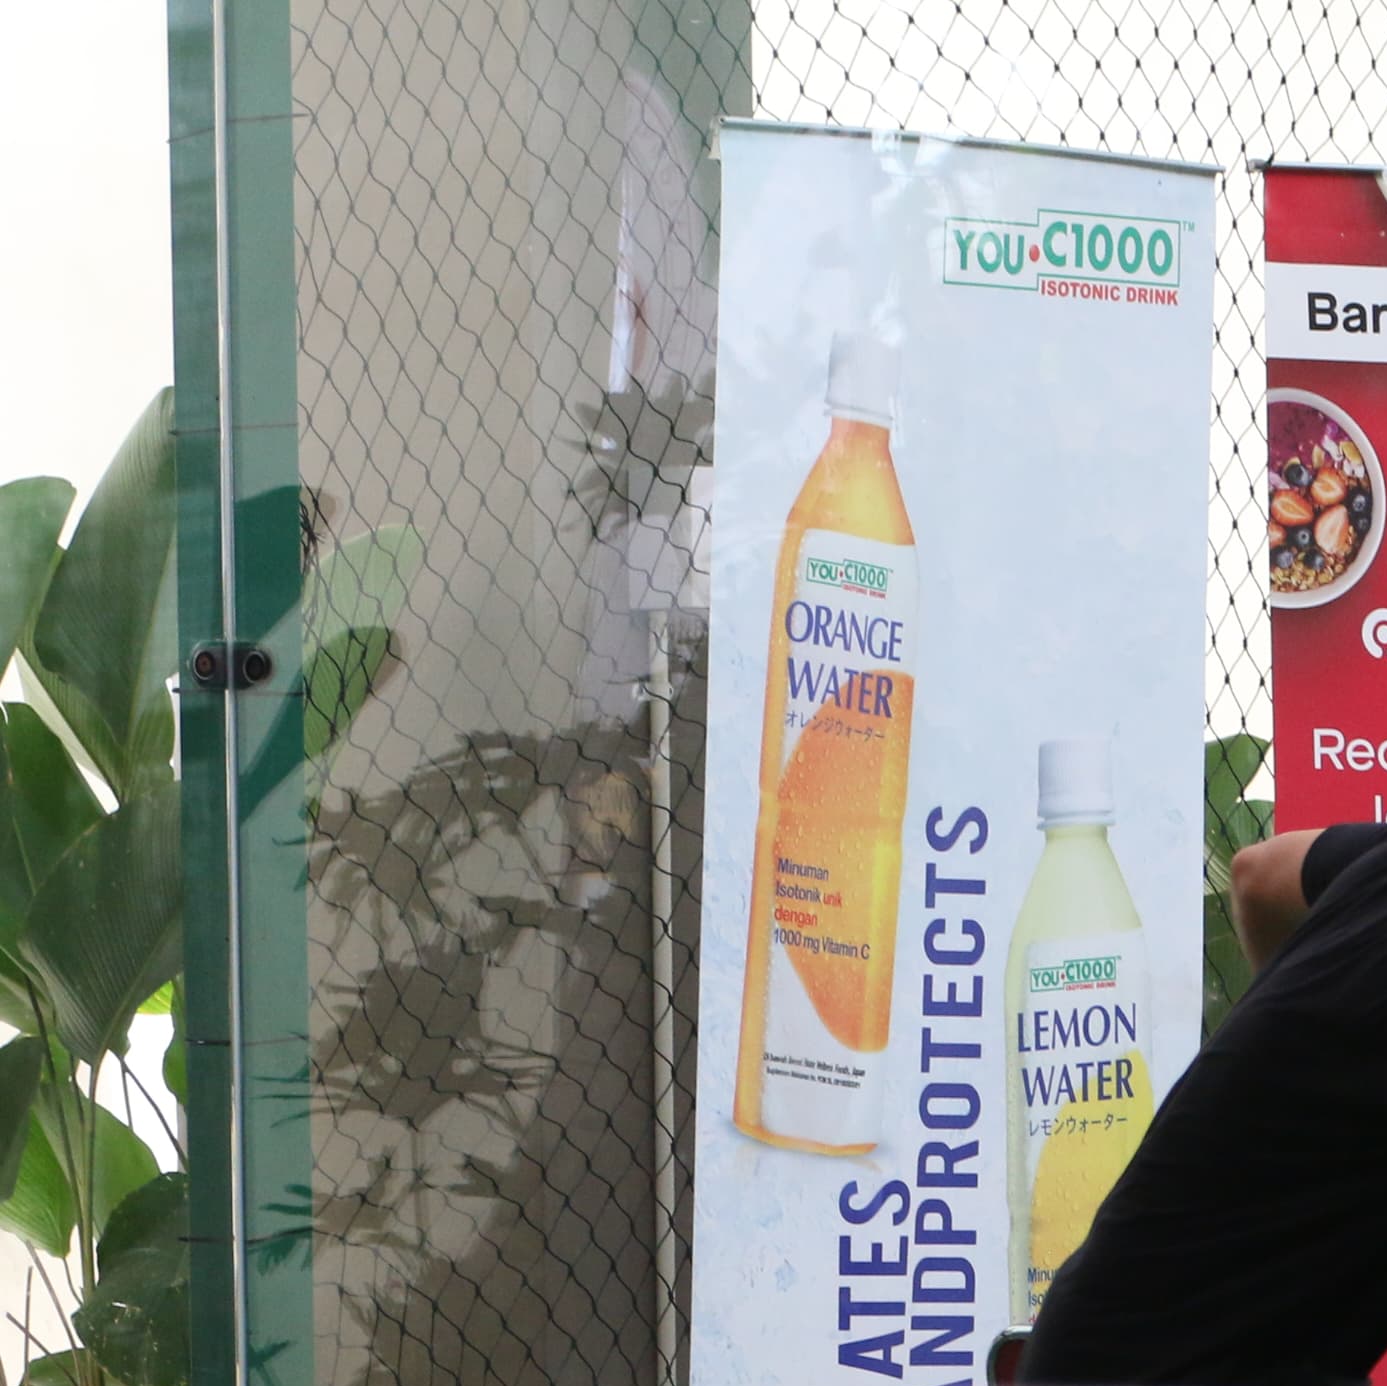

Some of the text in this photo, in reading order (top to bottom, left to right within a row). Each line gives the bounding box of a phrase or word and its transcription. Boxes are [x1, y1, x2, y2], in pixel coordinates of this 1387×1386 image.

[1041, 279, 1178, 306] ISOTONIC DRINK
[785, 601, 903, 662] ORANGE
[787, 657, 893, 719] WATER
[778, 858, 828, 880] Minuman
[775, 880, 820, 903] Isotonik
[775, 906, 817, 927] dengan
[774, 928, 871, 960] 1000 mg Vitamin C
[1018, 1003, 1136, 1053] LEMON
[1022, 1059, 1134, 1107] WATER
[1029, 1113, 1127, 1136] レモンウォーター
